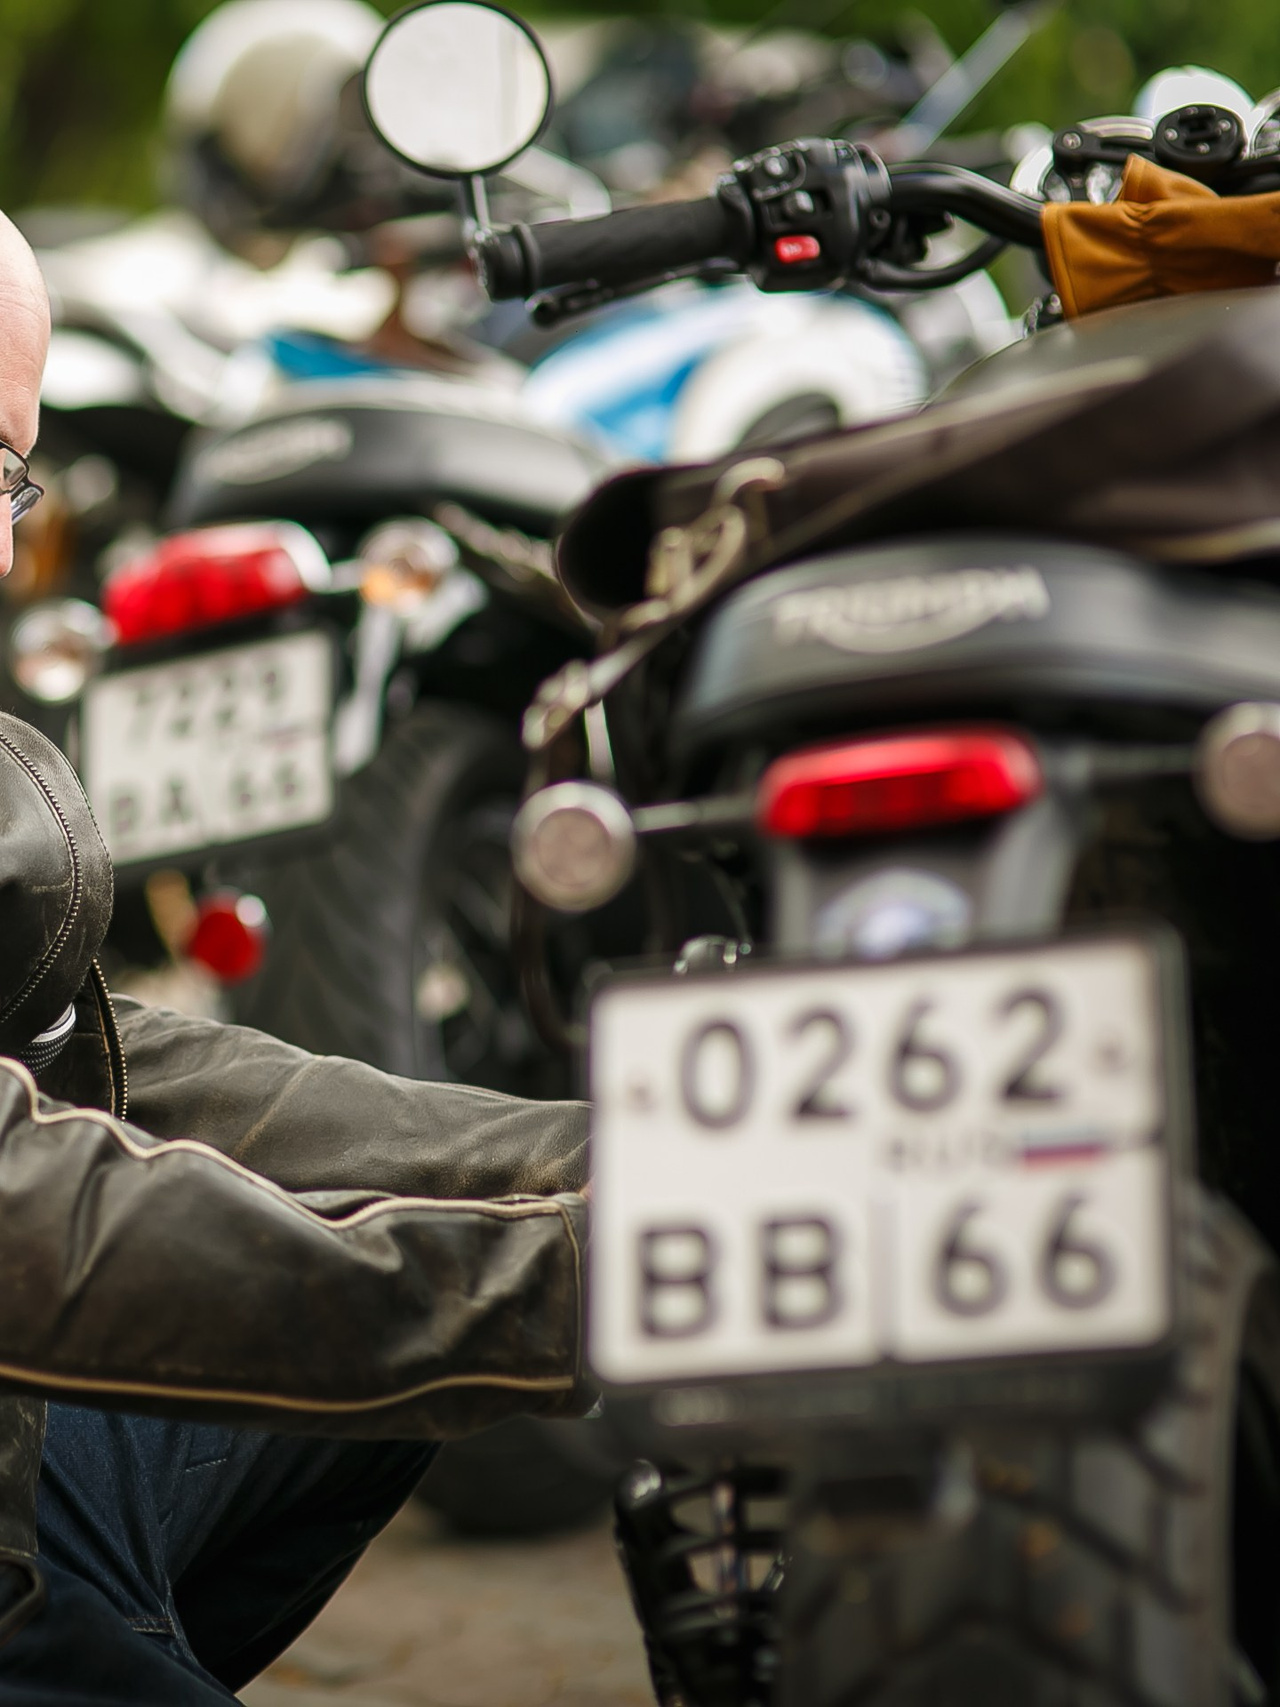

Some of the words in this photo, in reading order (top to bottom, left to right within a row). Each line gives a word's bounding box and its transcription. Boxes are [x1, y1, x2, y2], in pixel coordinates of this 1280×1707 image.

[679, 986, 1067, 1131] 0262
[638, 1211, 846, 1339] BB
[931, 1194, 1119, 1318] 66
